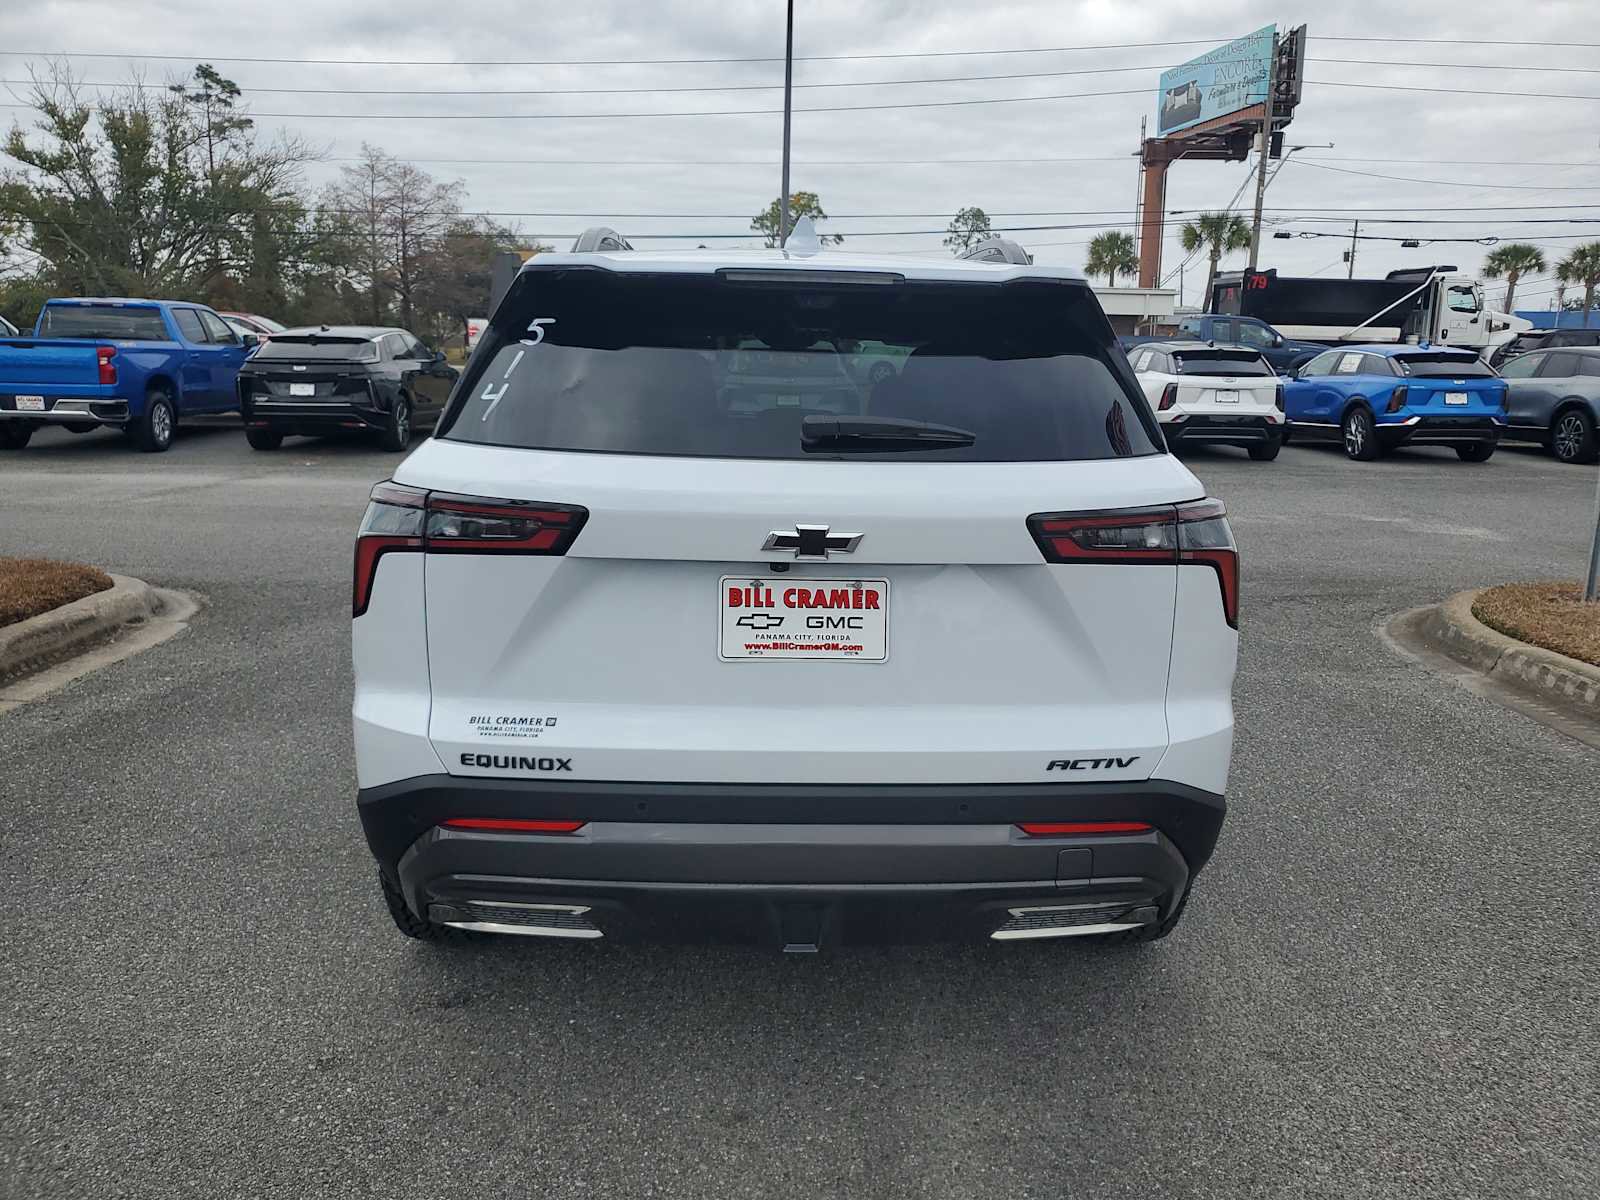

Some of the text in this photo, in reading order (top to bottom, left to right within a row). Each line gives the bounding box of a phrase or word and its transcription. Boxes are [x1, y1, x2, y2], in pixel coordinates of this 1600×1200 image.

[728, 587, 880, 610] BILL CRAMER
[806, 616, 864, 629] GMC
[755, 633, 851, 642] PANAMA CITY, FLORIDA
[744, 643, 863, 651] www.BillCramerGM.com
[469, 716, 491, 725] BILL
[496, 716, 543, 726] CRAMER
[460, 753, 573, 771] EQUINOX
[1046, 756, 1141, 771] ACTIV
